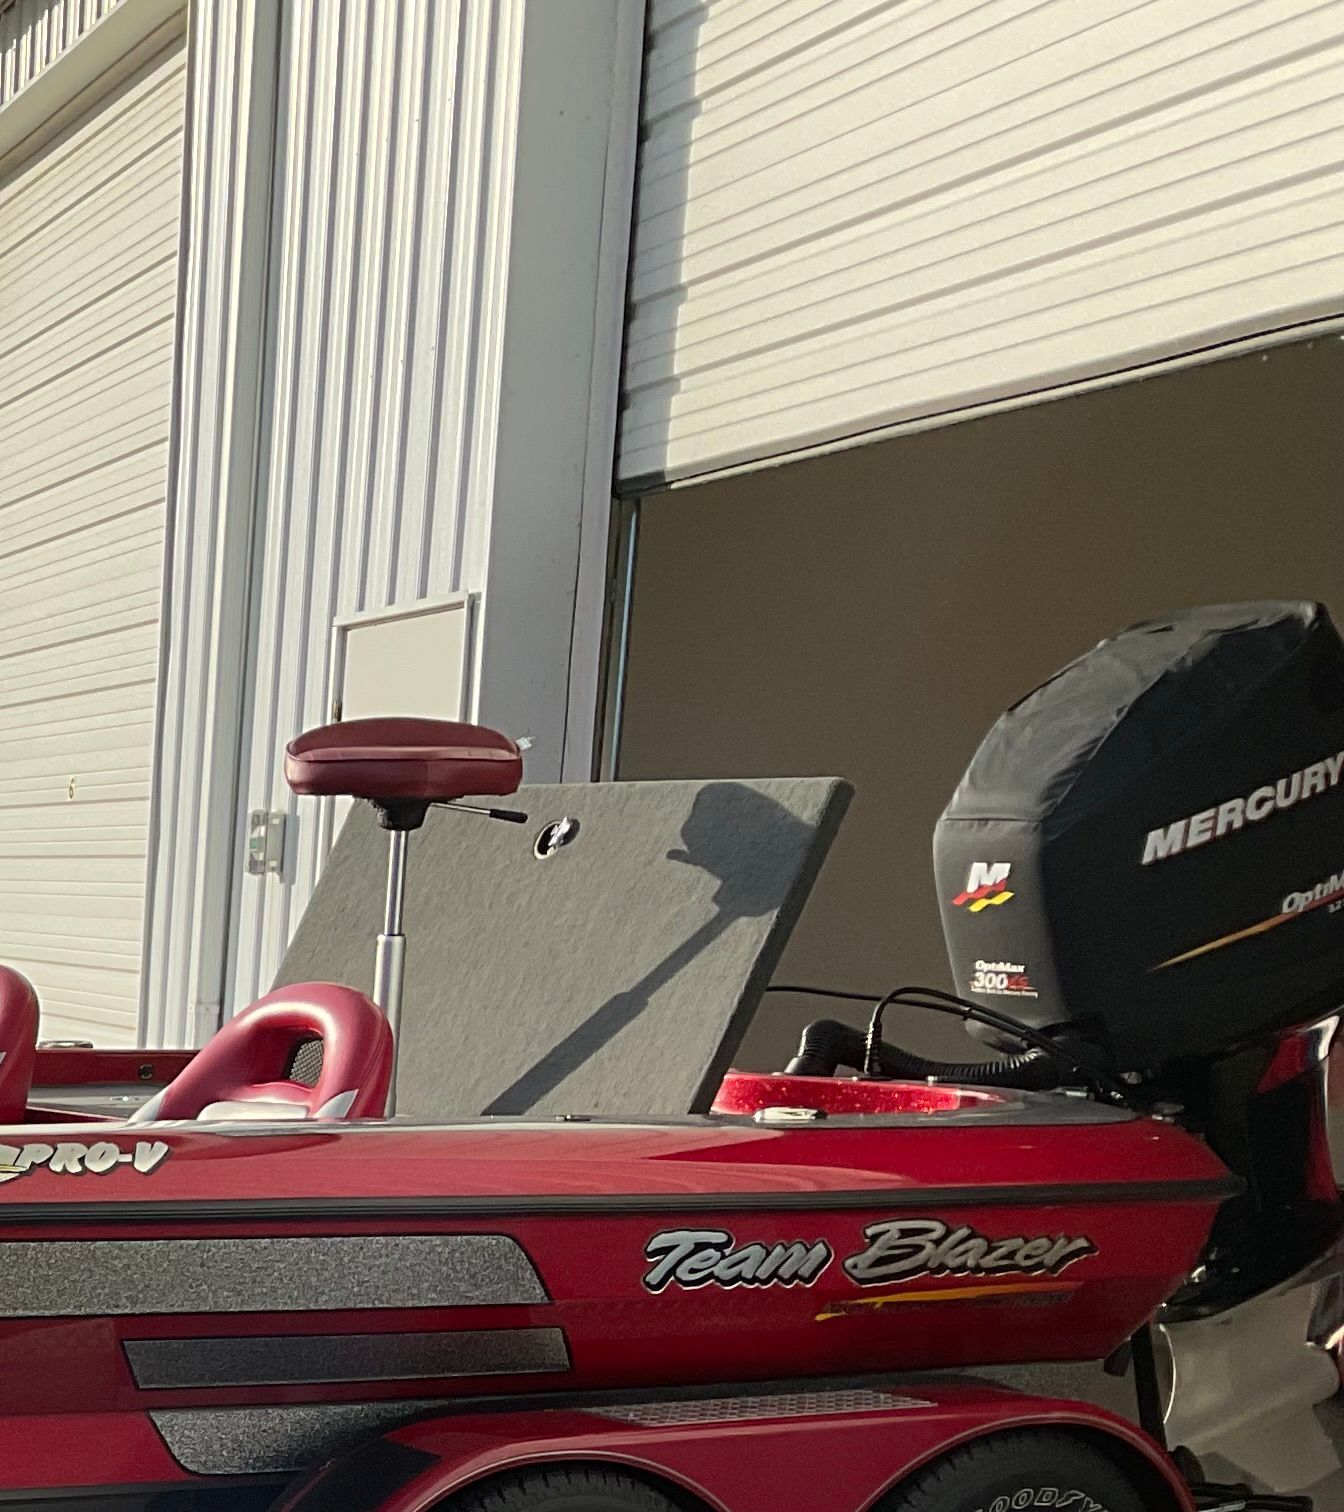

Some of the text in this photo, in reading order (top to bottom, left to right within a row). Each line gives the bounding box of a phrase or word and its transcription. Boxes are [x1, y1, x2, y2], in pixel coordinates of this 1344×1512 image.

[1141, 751, 1344, 865] MERCURY
[14, 1141, 170, 1175] PRO-V
[642, 1217, 1099, 1293] Team Blazer
